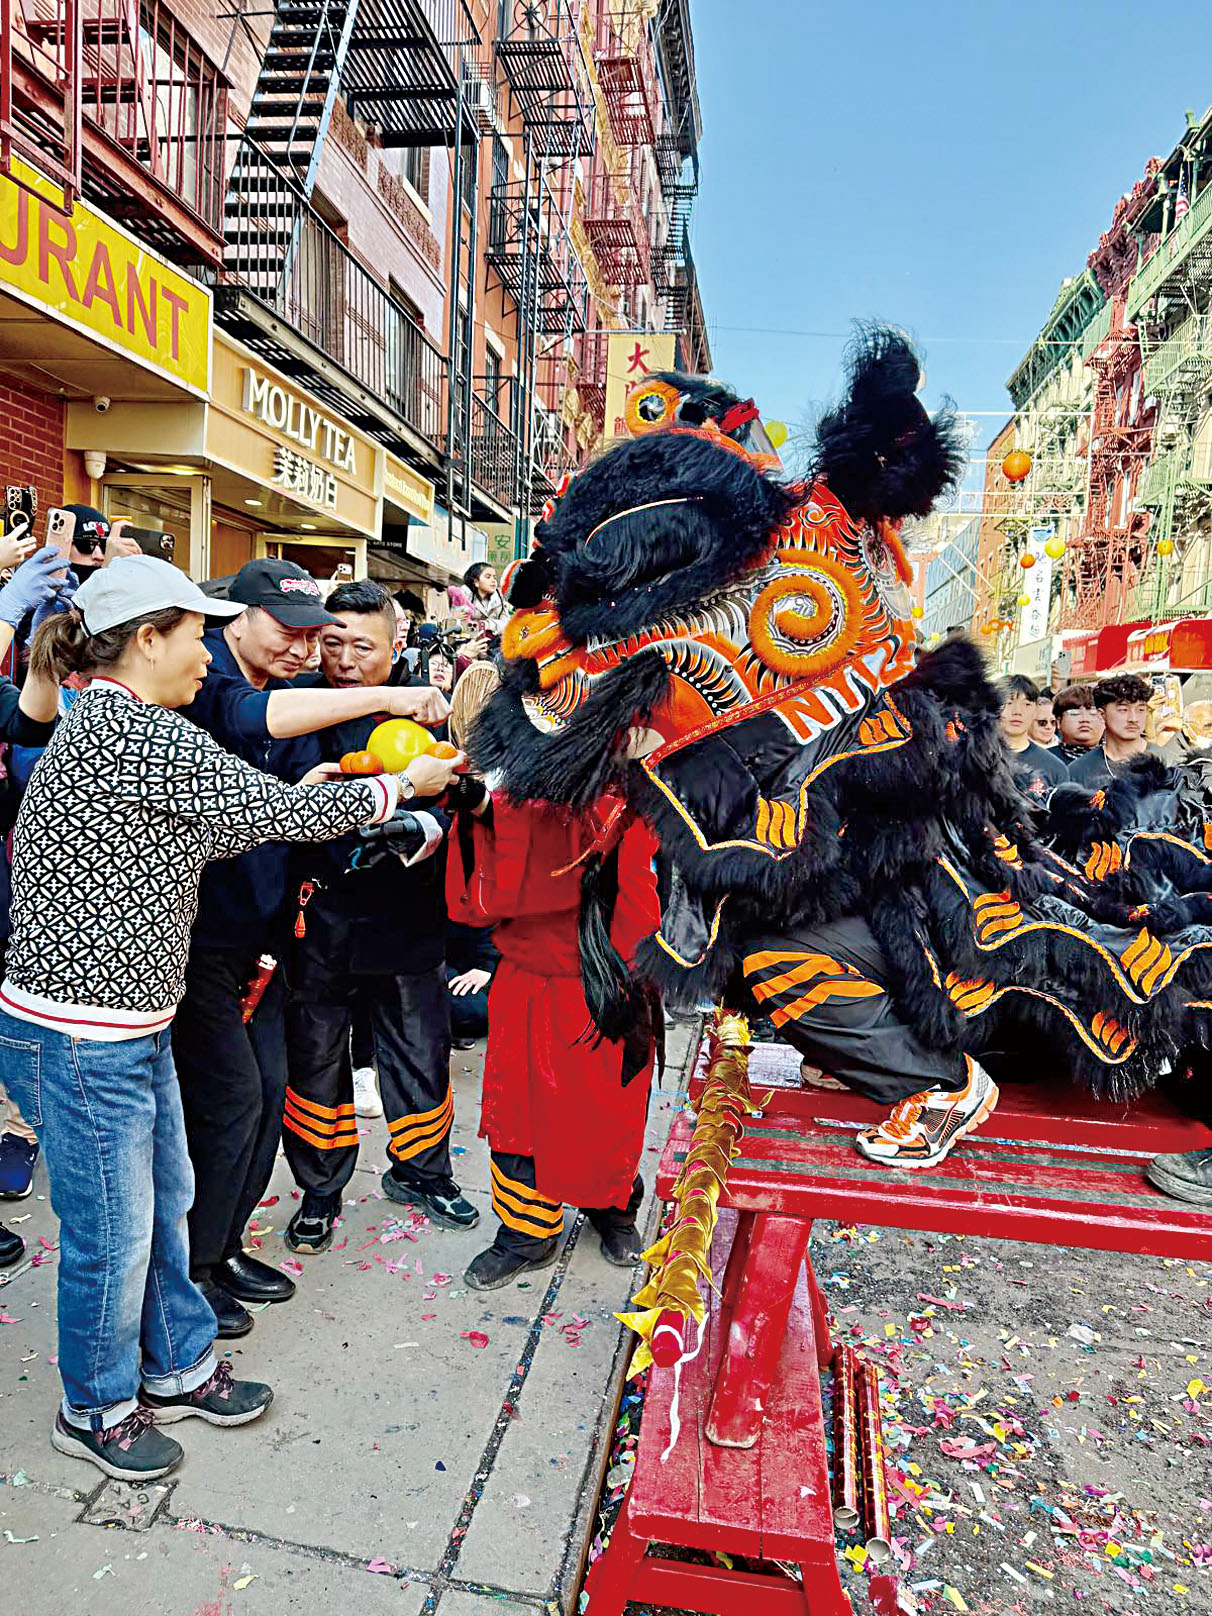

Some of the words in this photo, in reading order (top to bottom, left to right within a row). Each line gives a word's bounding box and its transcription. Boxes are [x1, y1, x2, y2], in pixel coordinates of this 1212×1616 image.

[246, 366, 322, 449] MOLLY
[321, 418, 358, 476] TEA
[271, 446, 338, 511] 茉莉奶白
